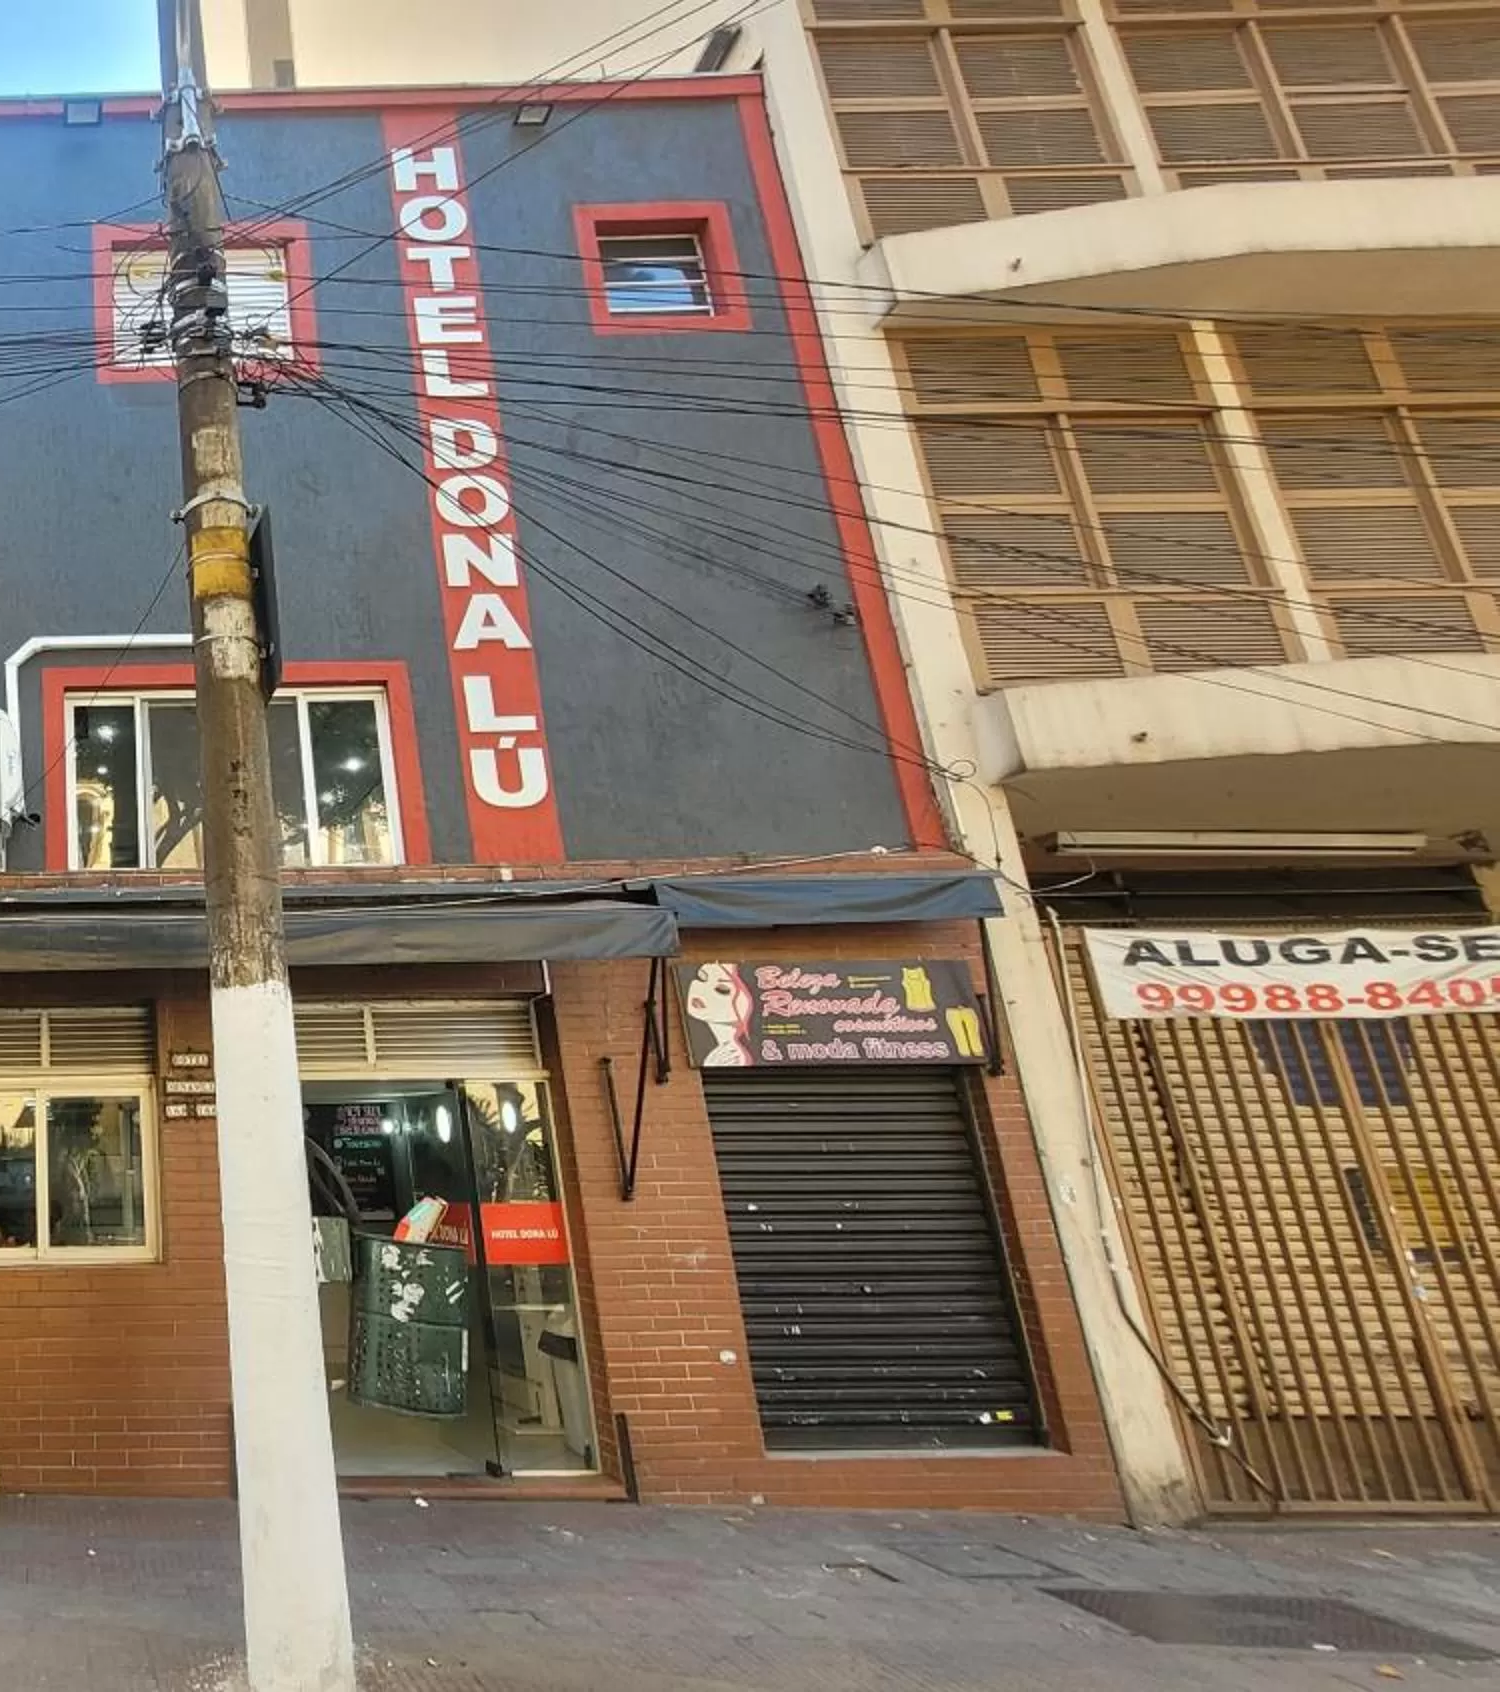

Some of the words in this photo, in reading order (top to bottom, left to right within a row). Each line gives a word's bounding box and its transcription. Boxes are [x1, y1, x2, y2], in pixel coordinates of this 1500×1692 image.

[391, 147, 489, 397] HOTEL
[429, 418, 532, 650] DONA
[463, 675, 548, 808] LÚ
[1123, 935, 1500, 967] ALUGA-SE
[1136, 975, 1500, 1013] 99988-840
[787, 1037, 860, 1060] moda
[862, 1037, 950, 1060] fitness
[491, 1229, 518, 1239] HOTEL
